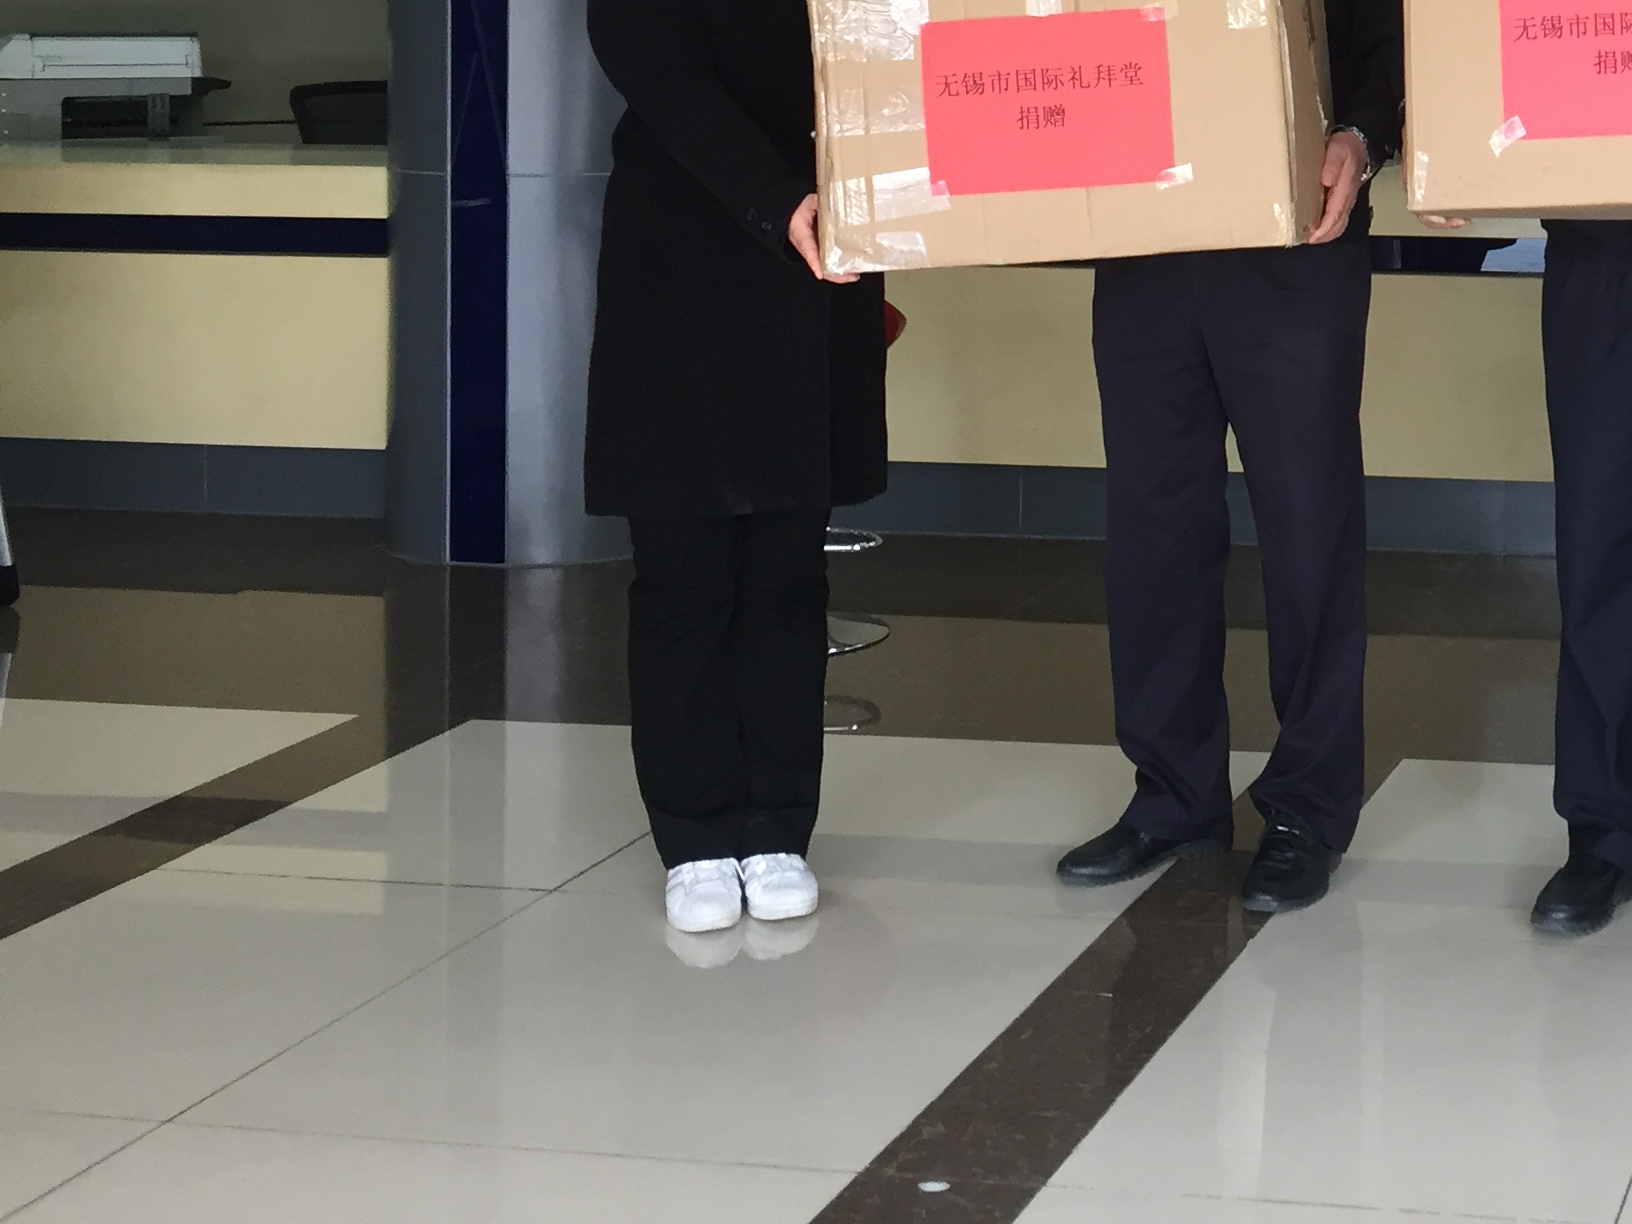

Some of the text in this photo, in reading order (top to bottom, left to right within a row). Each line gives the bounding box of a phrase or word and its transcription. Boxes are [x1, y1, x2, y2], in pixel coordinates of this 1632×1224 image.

[934, 61, 1144, 98] 无锡市国际礼拜堂
[1016, 104, 1066, 130] 捐赠
